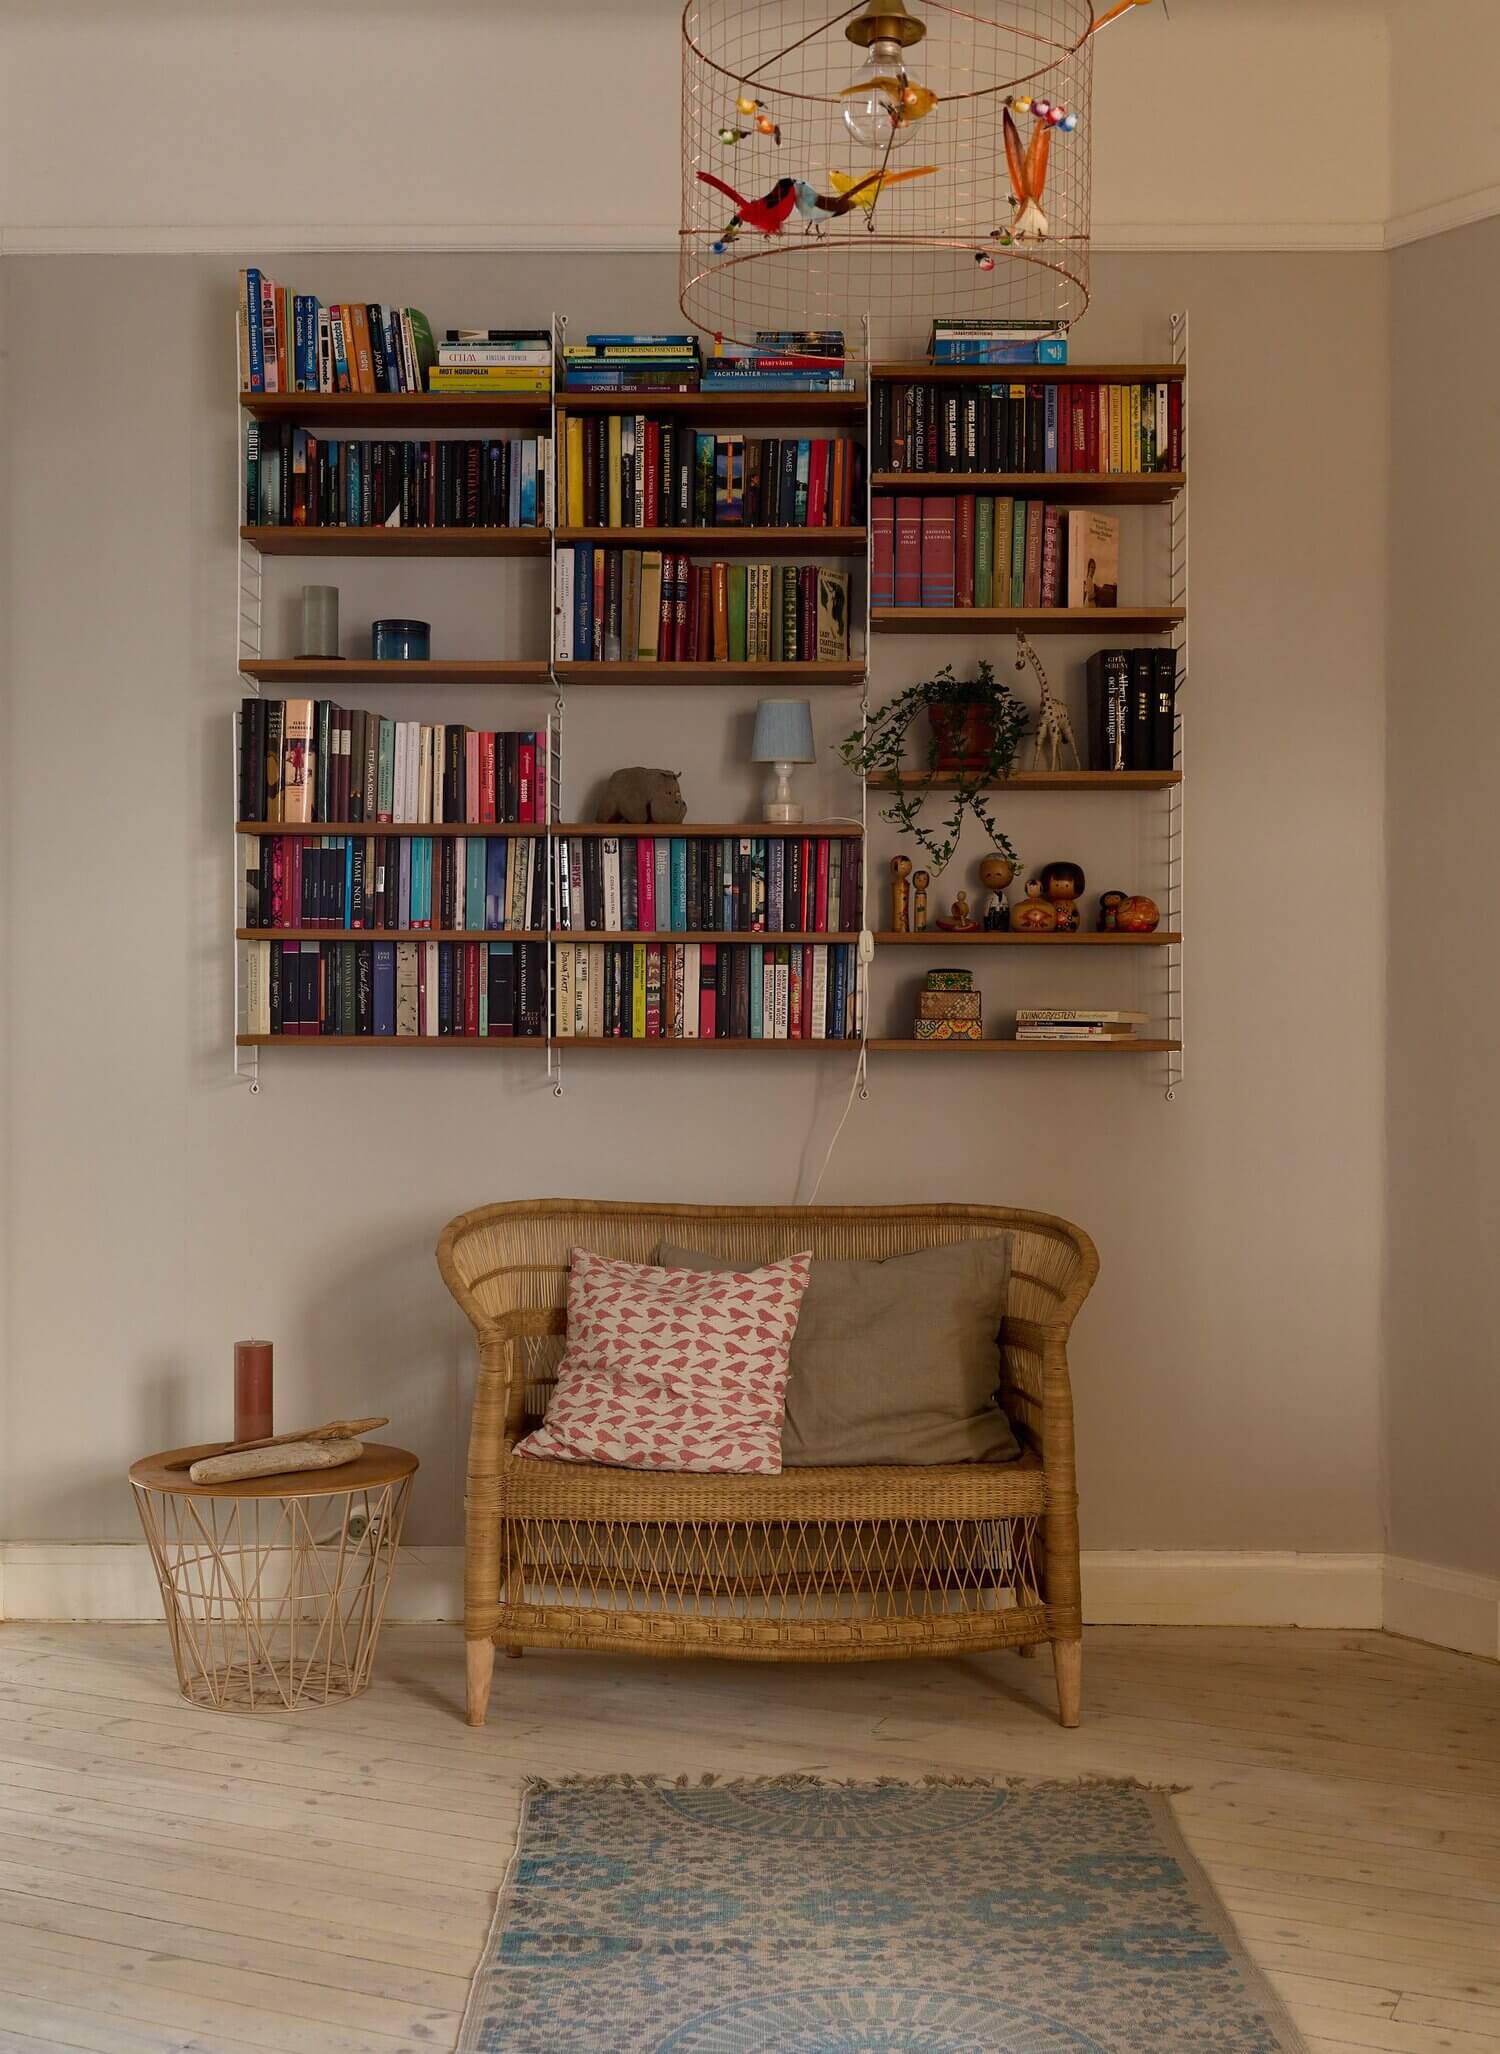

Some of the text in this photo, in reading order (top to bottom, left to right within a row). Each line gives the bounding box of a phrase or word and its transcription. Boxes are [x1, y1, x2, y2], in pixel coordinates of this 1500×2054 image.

[374, 351, 384, 379] JAPAN
[448, 353, 477, 362] WILD
[636, 420, 644, 444] Veikko
[916, 387, 924, 470] Ondskan JAN GUILLOU
[249, 429, 259, 460] GIOLITO
[636, 445, 644, 480] Huovinen
[663, 434, 671, 495] HELIKOPTERRÅNET
[785, 449, 793, 473] JAMES
[998, 503, 1008, 529] Elena
[1015, 510, 1025, 534] Elena
[1031, 510, 1040, 535] Elena
[979, 503, 989, 571] Elena Ferrante
[1106, 676, 1118, 744] och sanningen
[1116, 673, 1128, 734] Albert Speer
[366, 750, 376, 811] ETT JÄVLA SOLSKEN
[354, 850, 363, 911] TIMME NOLL
[572, 866, 581, 888] RYSK
[560, 951, 570, 972] DONNA
[344, 955, 352, 1019] HOWARDS END
[560, 972, 569, 994] TARTT
